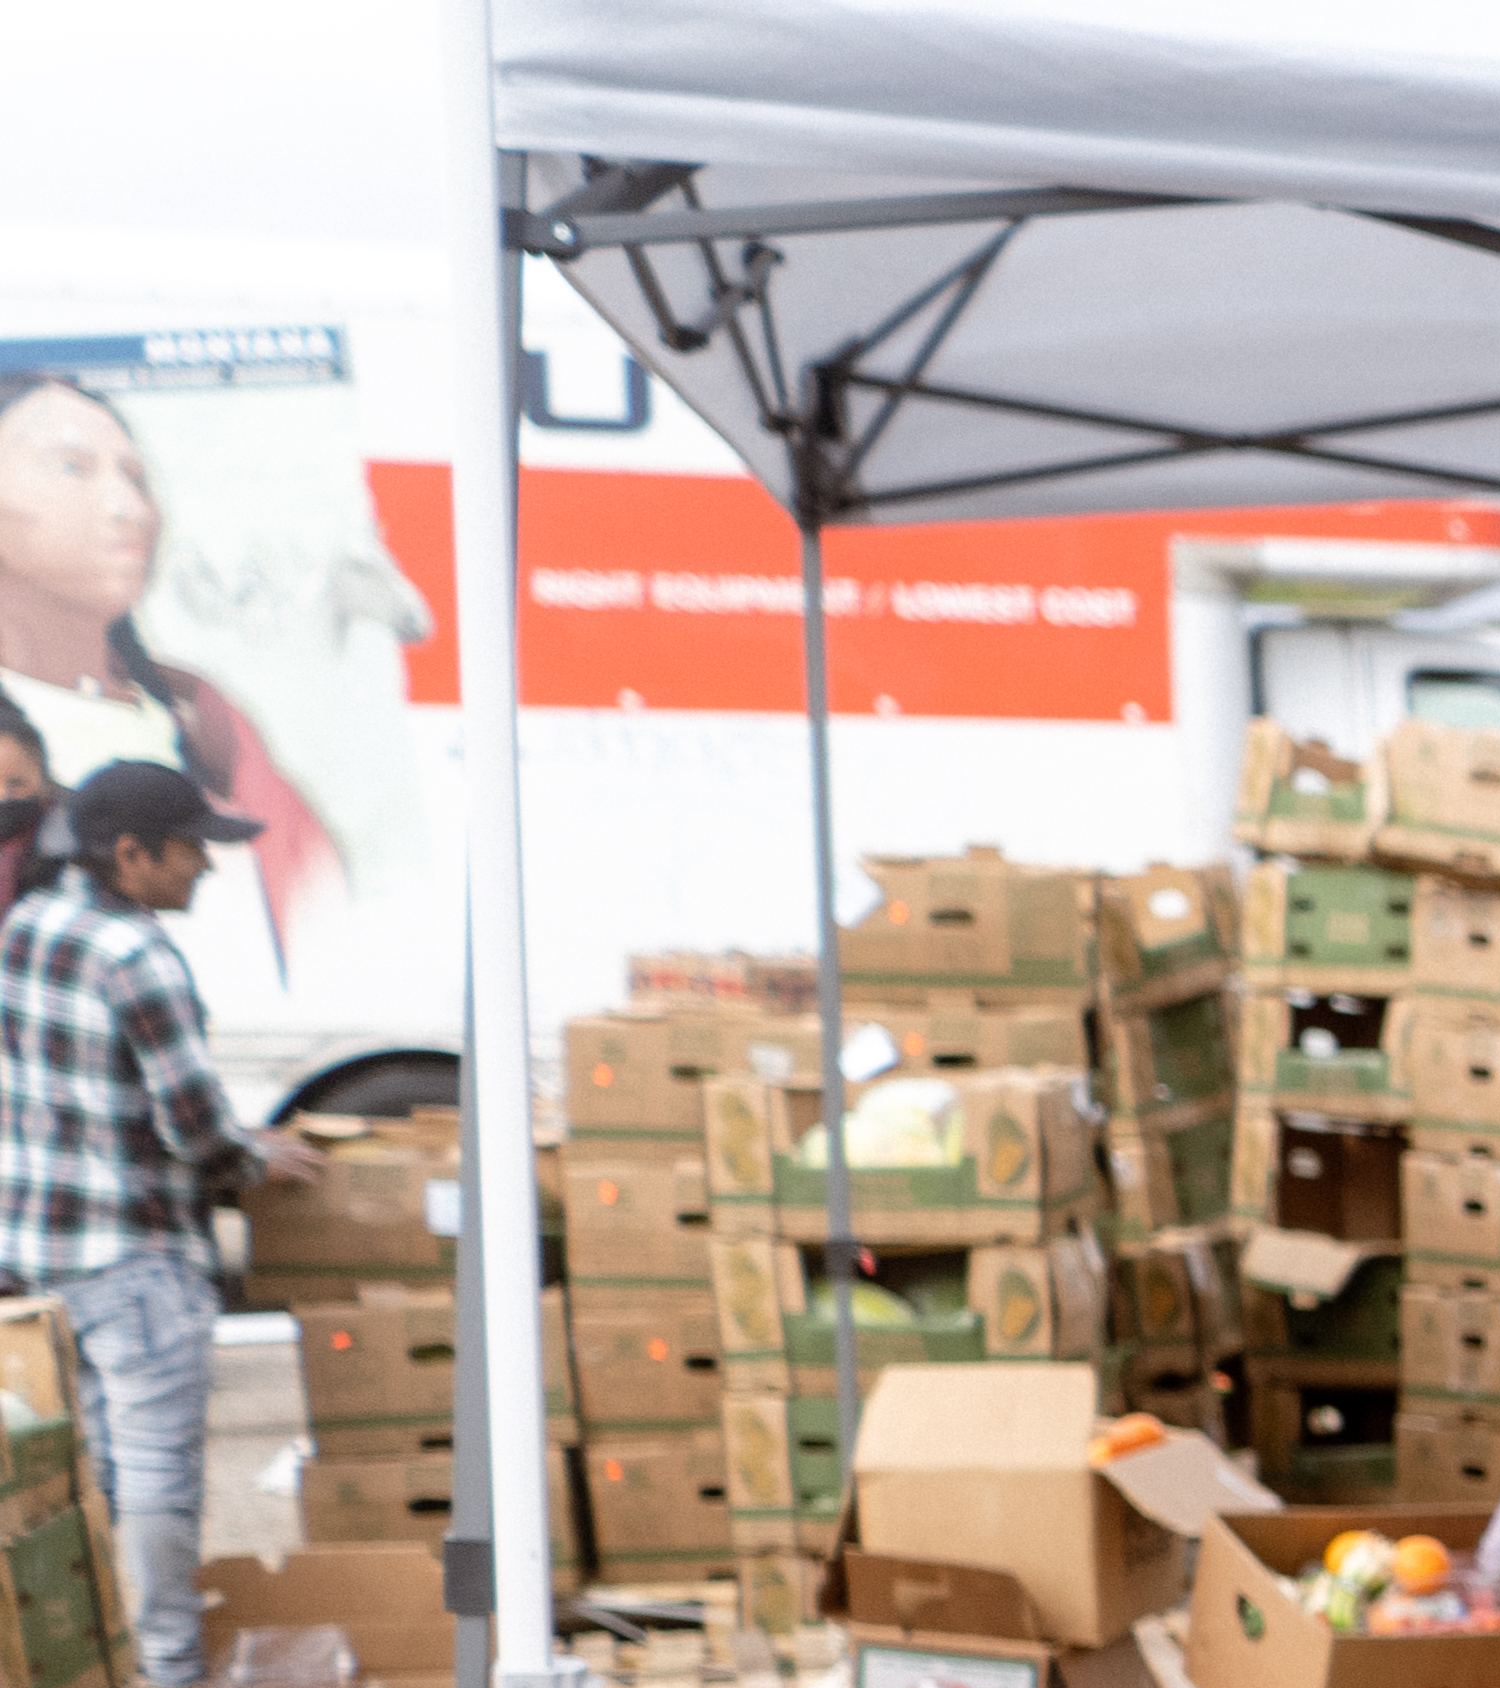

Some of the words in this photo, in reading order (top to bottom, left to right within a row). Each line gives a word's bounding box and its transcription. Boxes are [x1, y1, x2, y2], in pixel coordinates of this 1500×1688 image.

[531, 568, 643, 611] RIGHT
[891, 582, 1036, 625] LOWEST
[1040, 586, 1137, 628] COST
